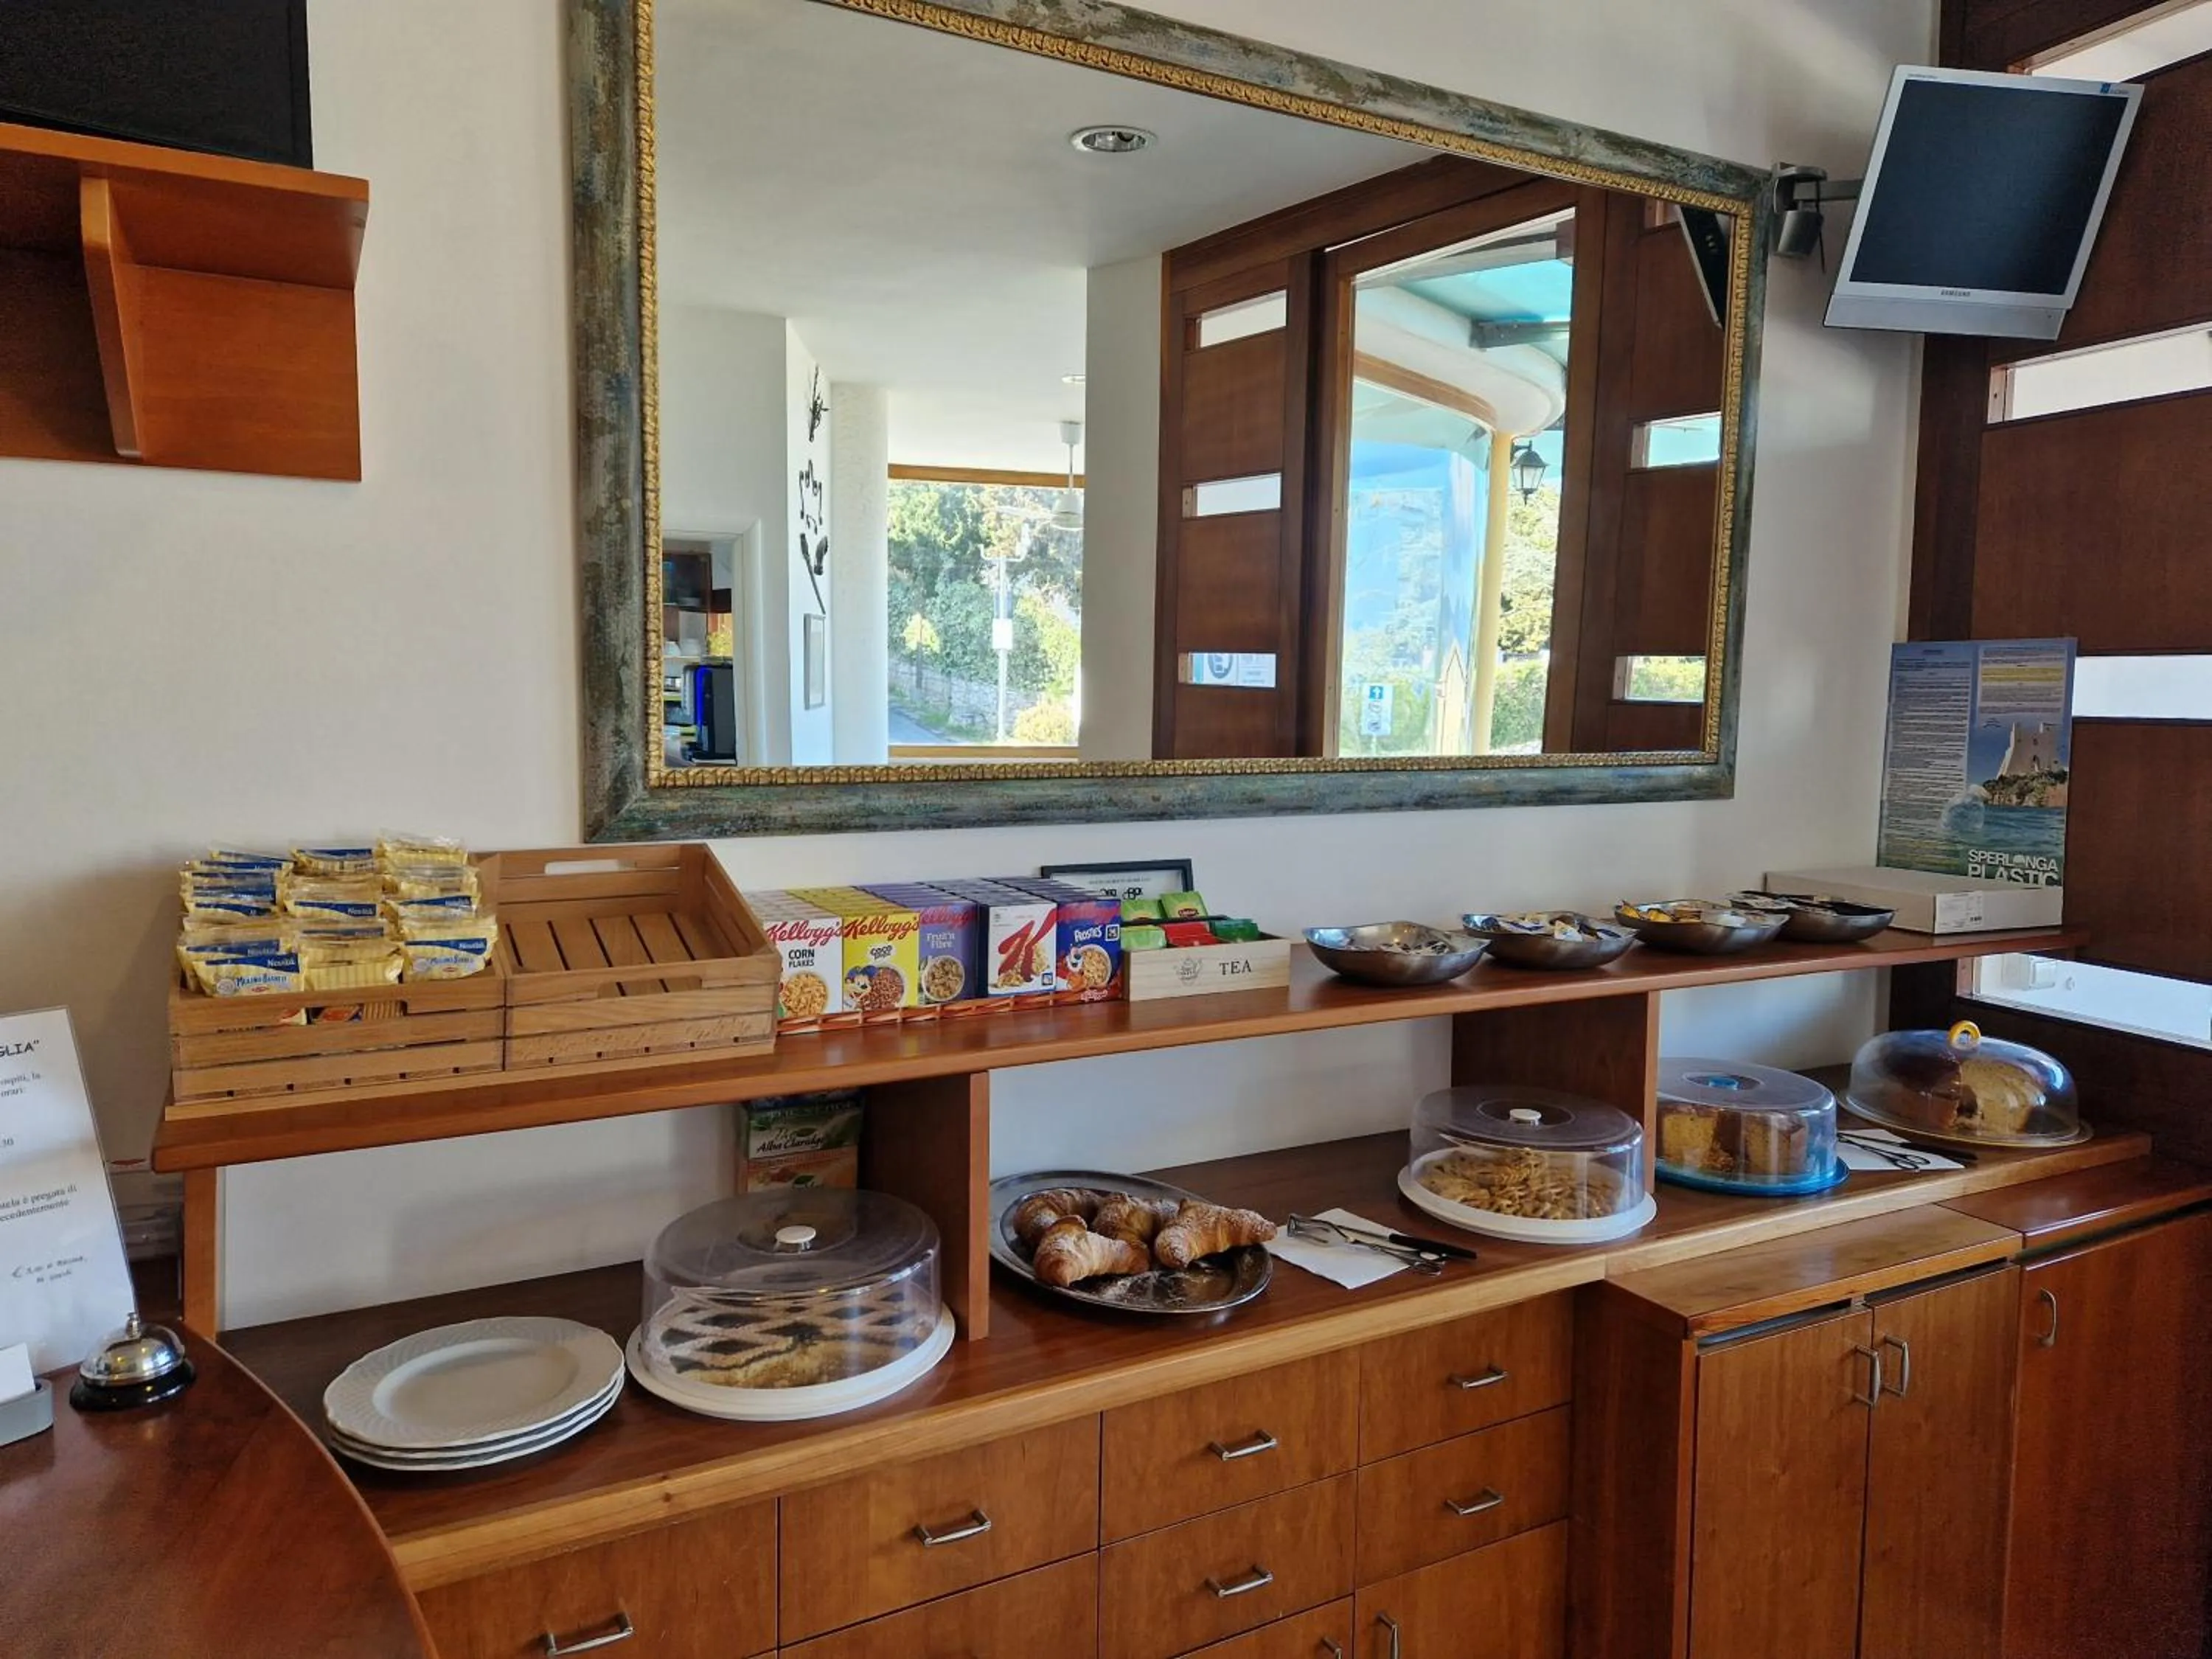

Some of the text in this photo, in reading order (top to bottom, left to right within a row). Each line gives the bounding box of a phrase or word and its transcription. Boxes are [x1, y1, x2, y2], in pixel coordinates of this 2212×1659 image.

[765, 919, 843, 947] Kellogg's
[843, 913, 920, 940] Kellogg's
[788, 949, 815, 960] CORN
[788, 959, 814, 968] FLAKES
[1219, 959, 1252, 975] TEA
